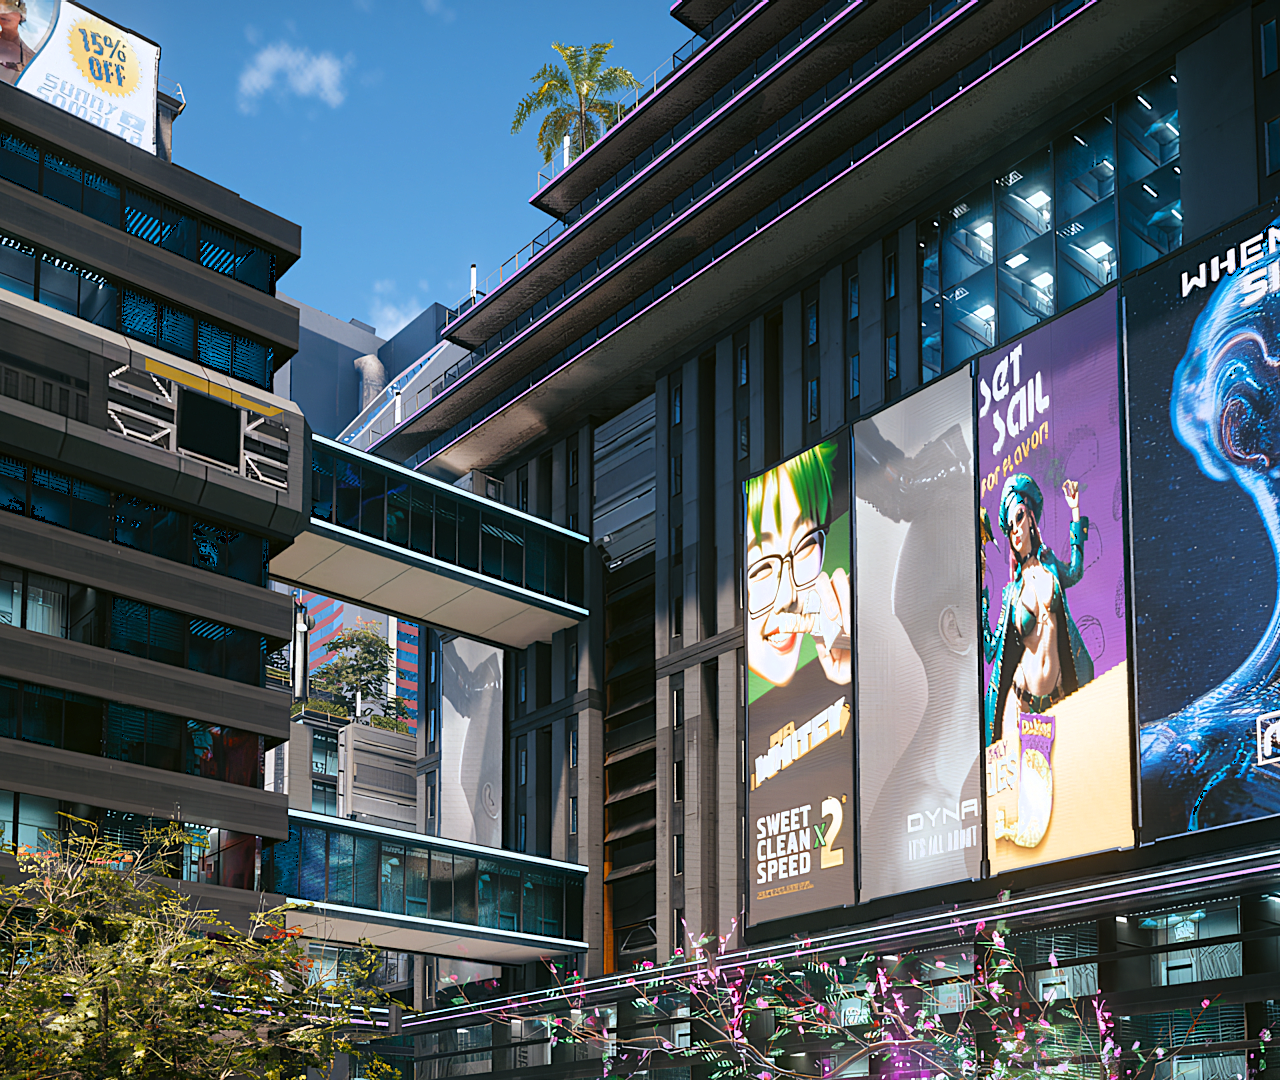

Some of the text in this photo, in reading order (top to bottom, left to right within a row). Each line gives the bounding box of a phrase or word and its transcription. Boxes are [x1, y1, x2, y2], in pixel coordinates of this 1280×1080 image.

[78, 28, 126, 62] 15%
[88, 56, 125, 87] OFF
[756, 804, 812, 840] SWEET
[756, 828, 811, 862] CLEAN
[756, 851, 811, 885] SPEED
